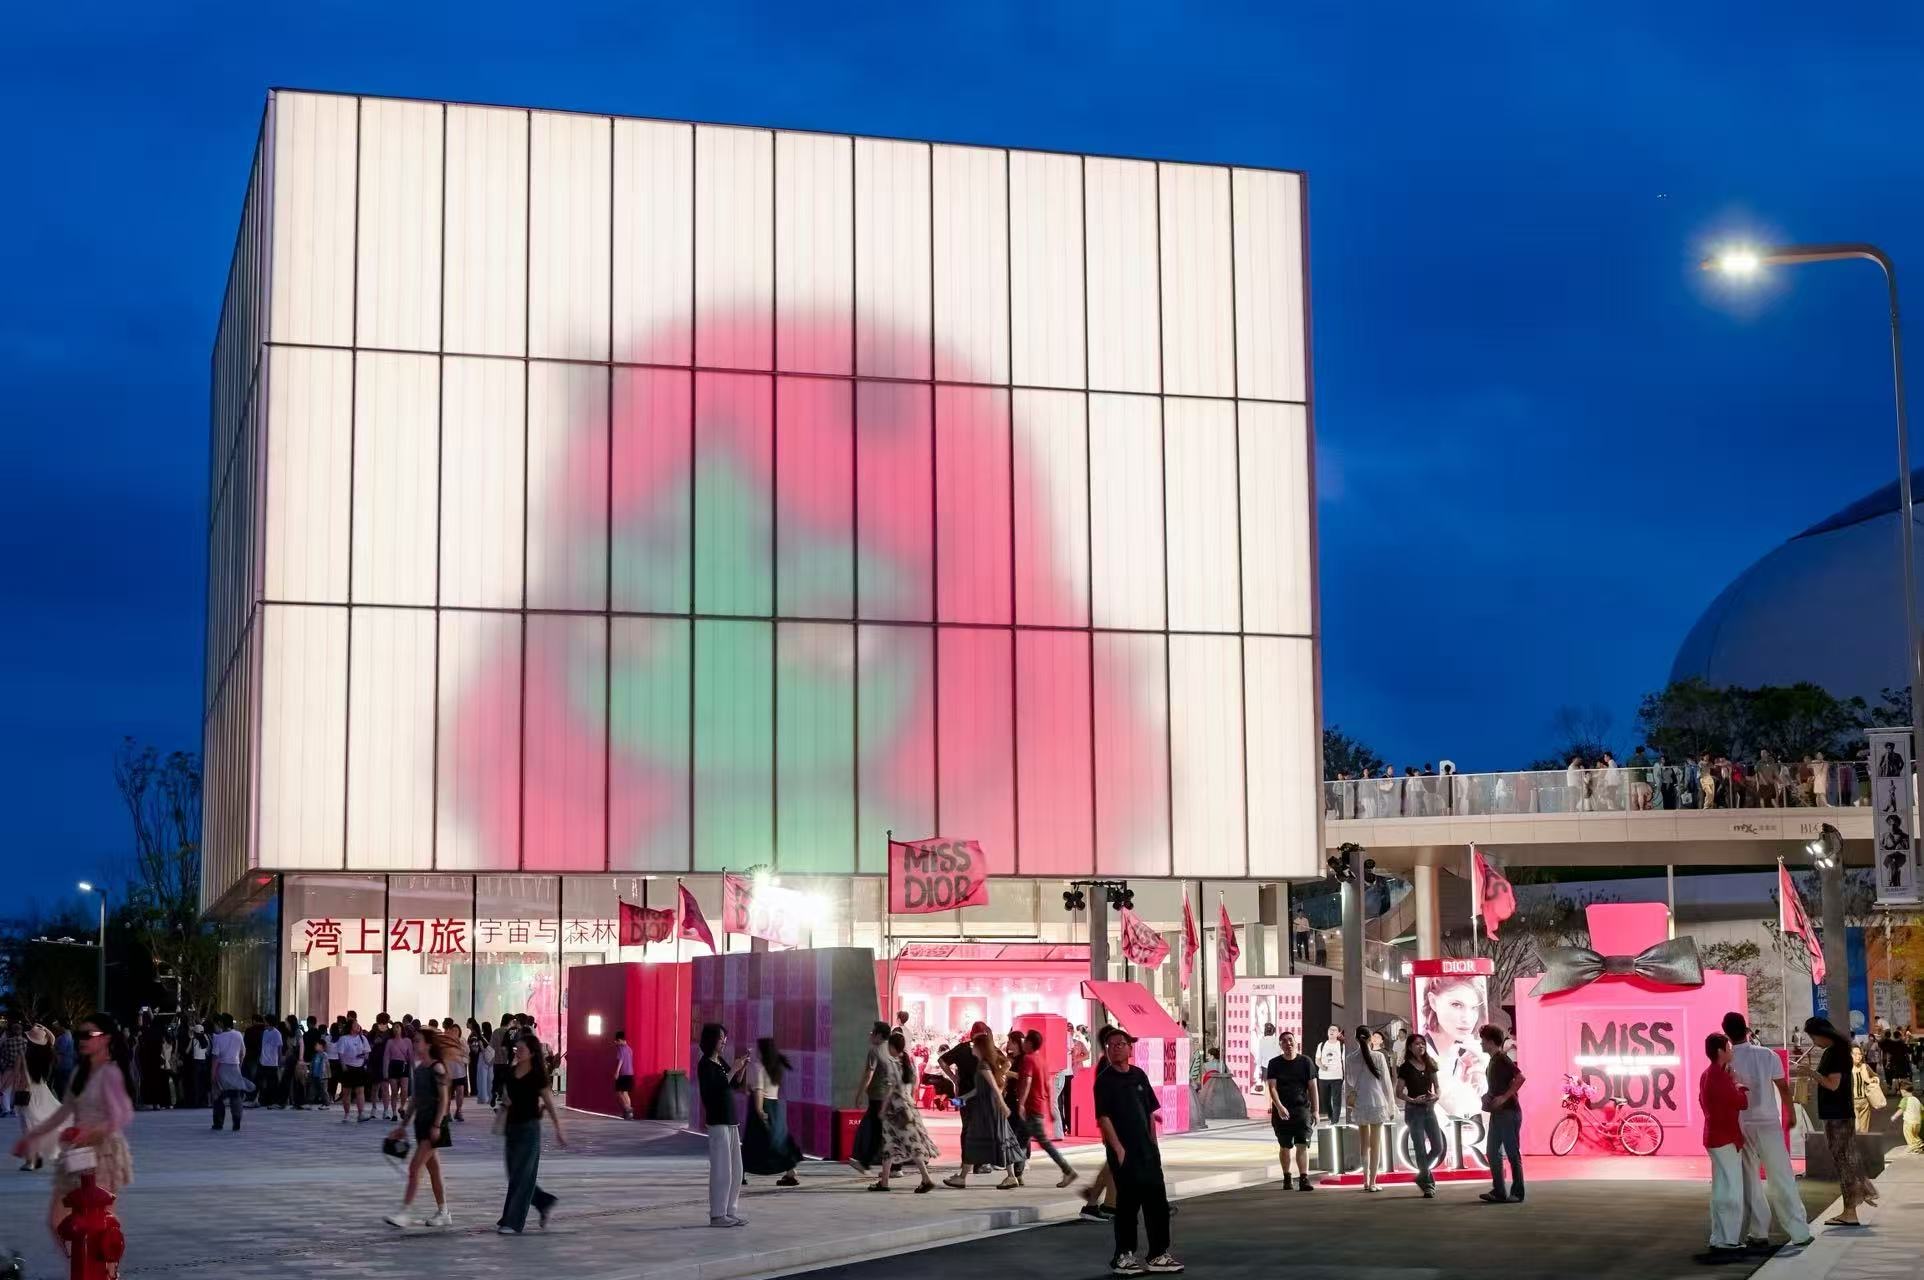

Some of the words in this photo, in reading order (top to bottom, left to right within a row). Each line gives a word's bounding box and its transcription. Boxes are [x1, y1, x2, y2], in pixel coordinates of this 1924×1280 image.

[904, 842, 972, 873] MISS
[304, 918, 467, 956] 湾上幻旅
[479, 918, 618, 945] 宇宙与森林
[1442, 961, 1476, 973] DIOR
[1163, 1042, 1177, 1060] MISS
[1581, 1021, 1675, 1057] MISS
[1163, 1062, 1177, 1082] DIOR
[1581, 1066, 1677, 1111] DIOR
[1561, 1100, 1579, 1113] DIOR
